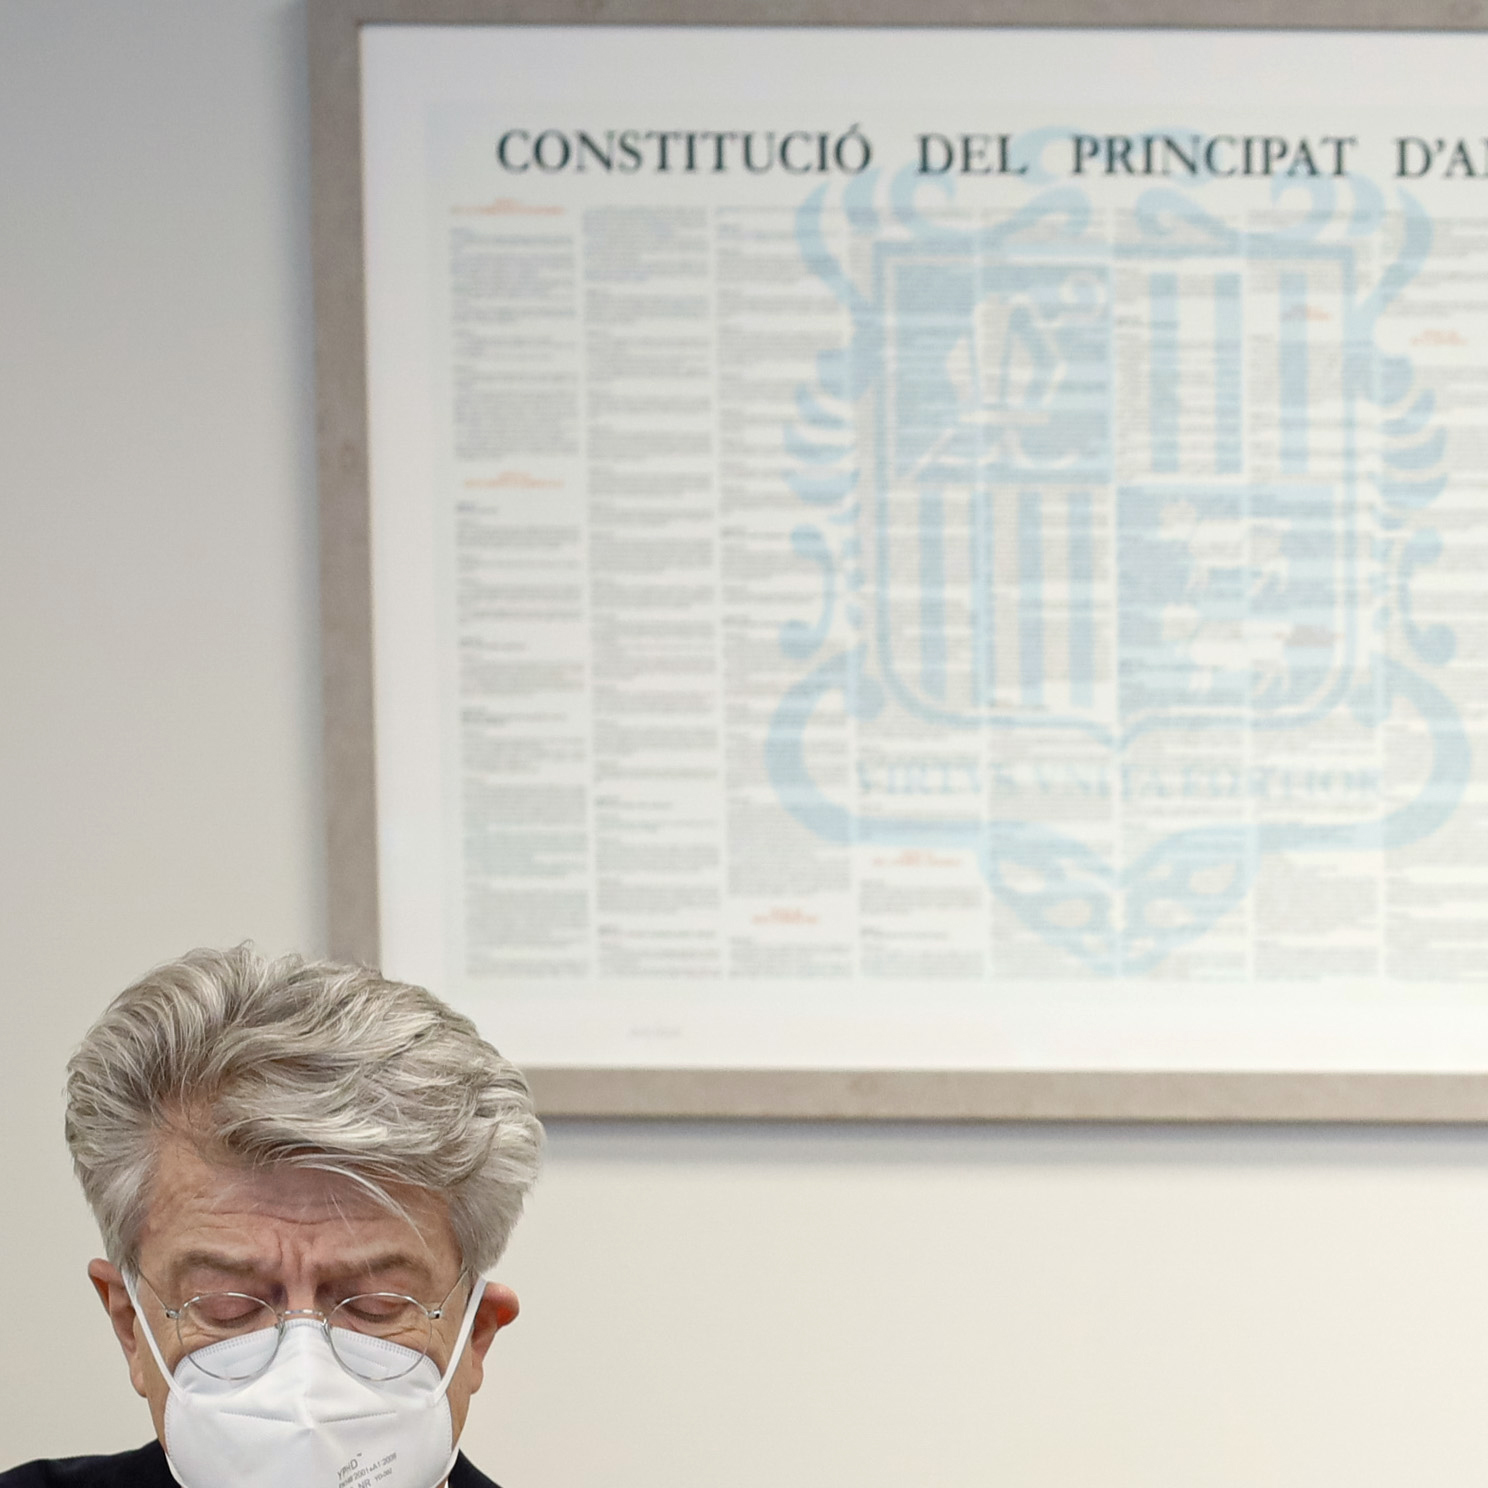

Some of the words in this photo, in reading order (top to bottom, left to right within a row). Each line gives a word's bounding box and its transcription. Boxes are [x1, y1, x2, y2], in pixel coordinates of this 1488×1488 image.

[496, 123, 873, 175] CONSTITUCIÓ
[915, 133, 1029, 177] DEL
[1071, 134, 1358, 178] PRINCIPAT
